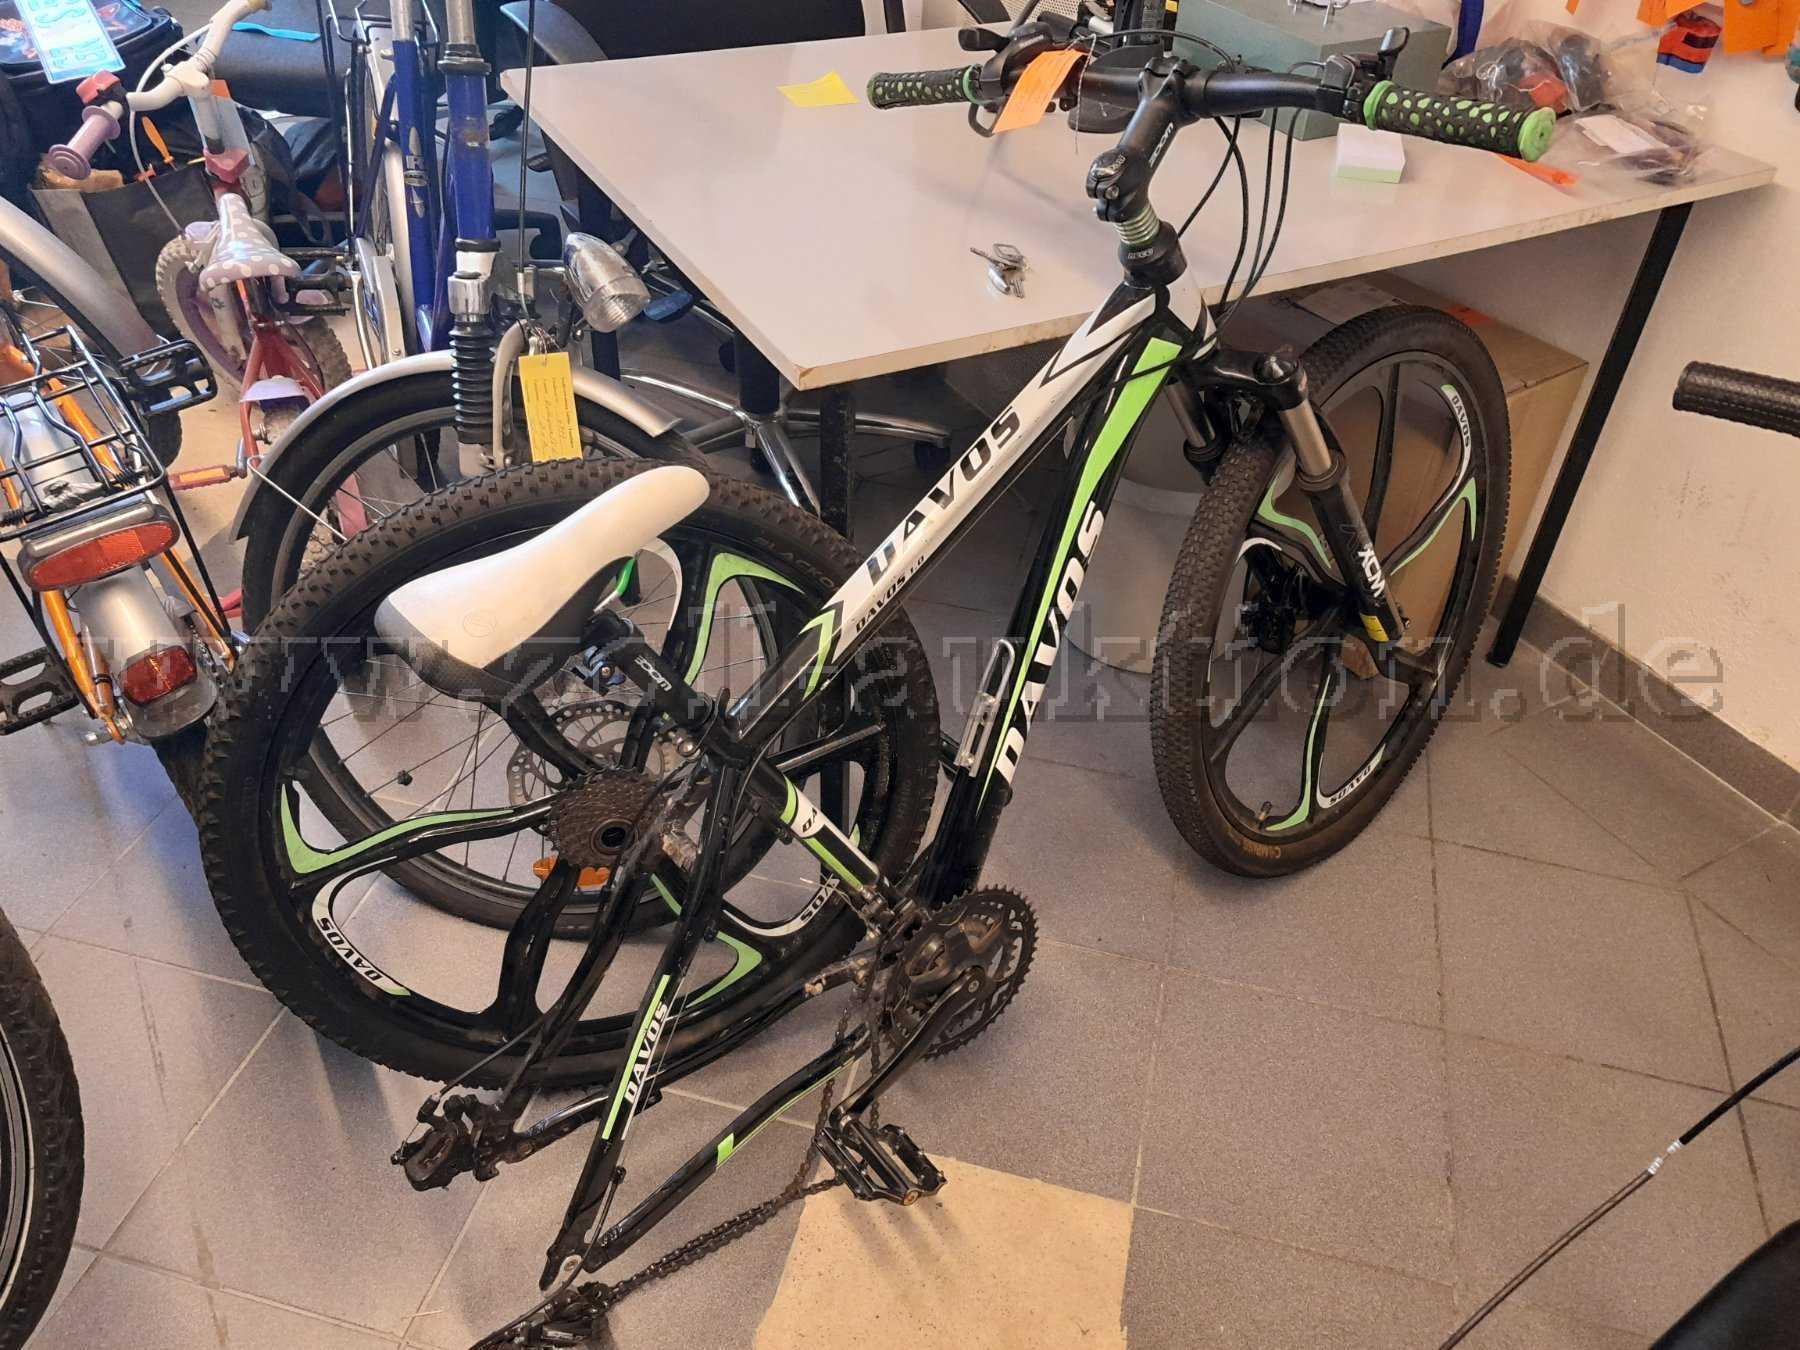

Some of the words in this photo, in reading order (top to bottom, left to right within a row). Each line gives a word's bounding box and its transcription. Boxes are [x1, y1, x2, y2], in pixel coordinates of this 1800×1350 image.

[1451, 394, 1471, 448] DAVOS
[866, 405, 1021, 586] DAVOS
[855, 574, 906, 633] DAVOS
[1356, 547, 1387, 599] XCM
[995, 499, 1105, 786] DAVOS
[317, 917, 383, 981] DAVOS
[623, 1001, 668, 1104] DAVOS
